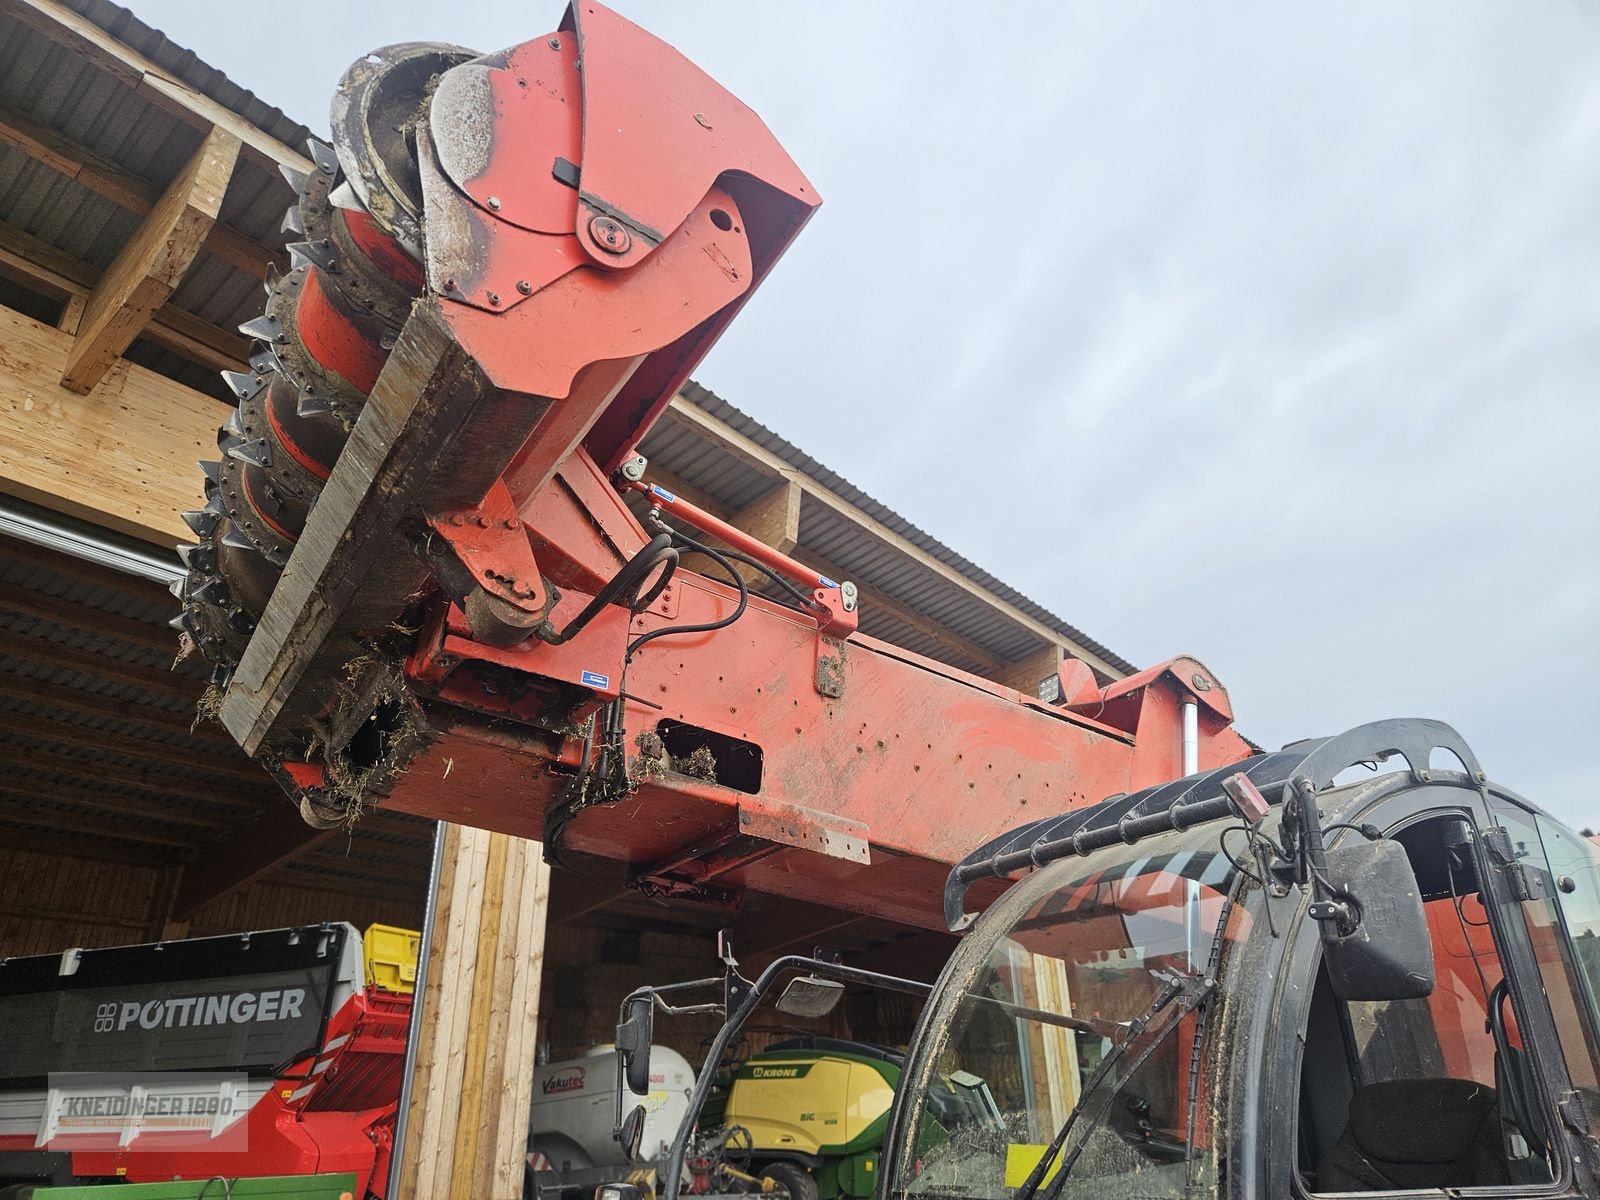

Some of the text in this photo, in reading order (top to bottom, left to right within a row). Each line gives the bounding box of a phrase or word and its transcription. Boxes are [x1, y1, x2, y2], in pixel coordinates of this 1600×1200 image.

[117, 988, 306, 1031] PÖTTINGER
[763, 1068, 798, 1078] KRONE
[543, 1075, 585, 1095] Vakutec
